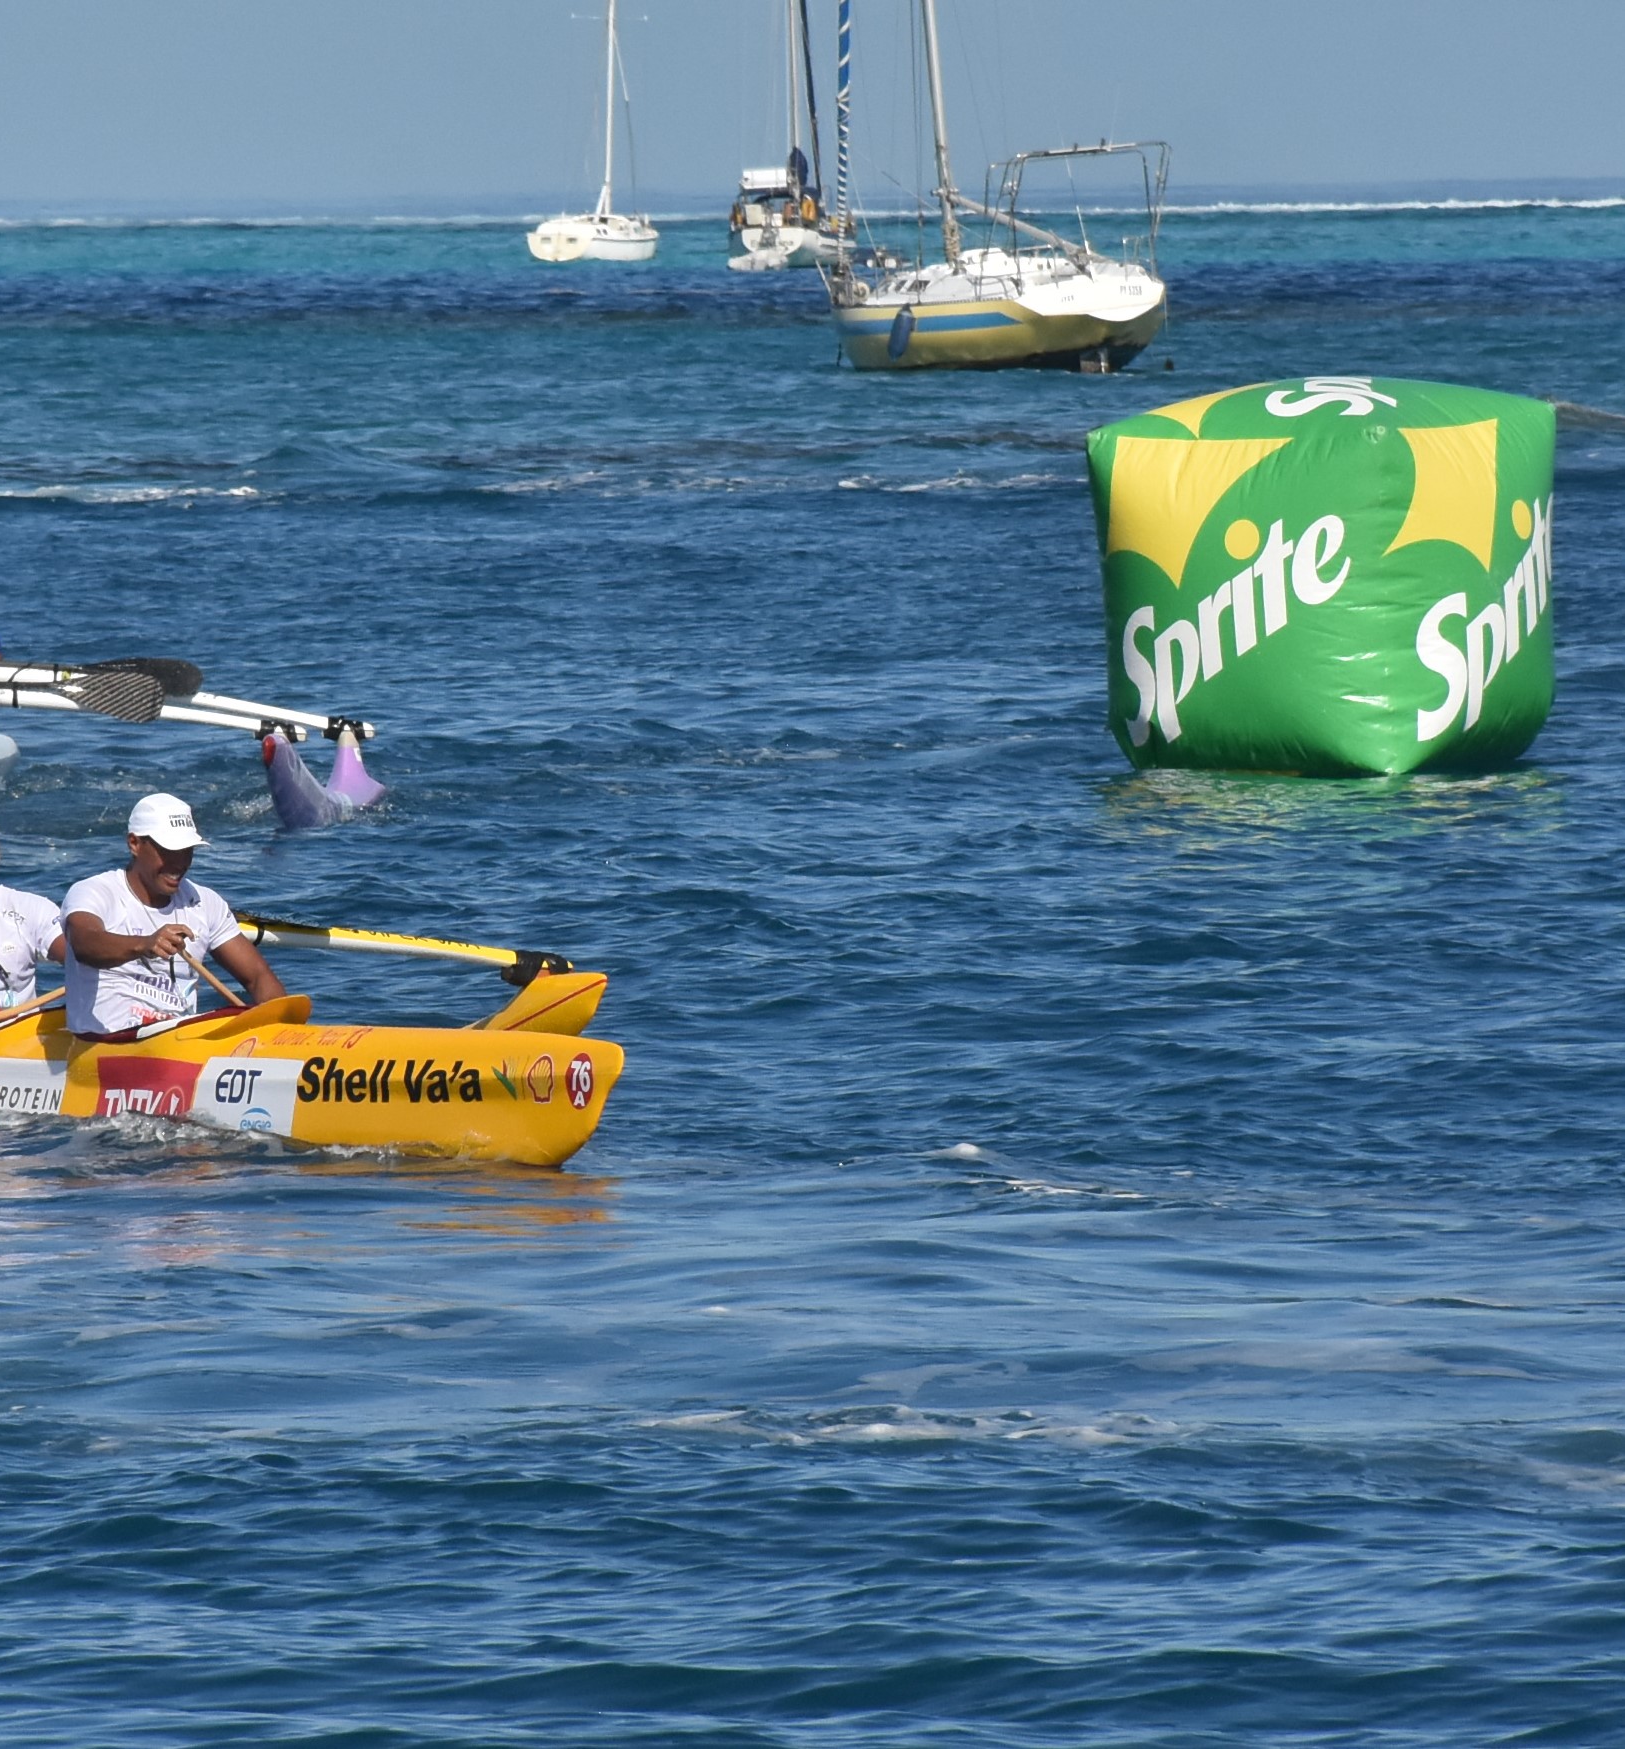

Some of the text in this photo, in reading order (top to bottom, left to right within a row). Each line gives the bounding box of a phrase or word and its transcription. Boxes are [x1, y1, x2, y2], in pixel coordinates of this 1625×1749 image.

[1122, 514, 1351, 748] Sprite
[215, 1068, 263, 1105] EDT
[296, 1056, 483, 1104] Shell Va'a
[570, 1060, 591, 1093] 76
[573, 1090, 586, 1107] A
